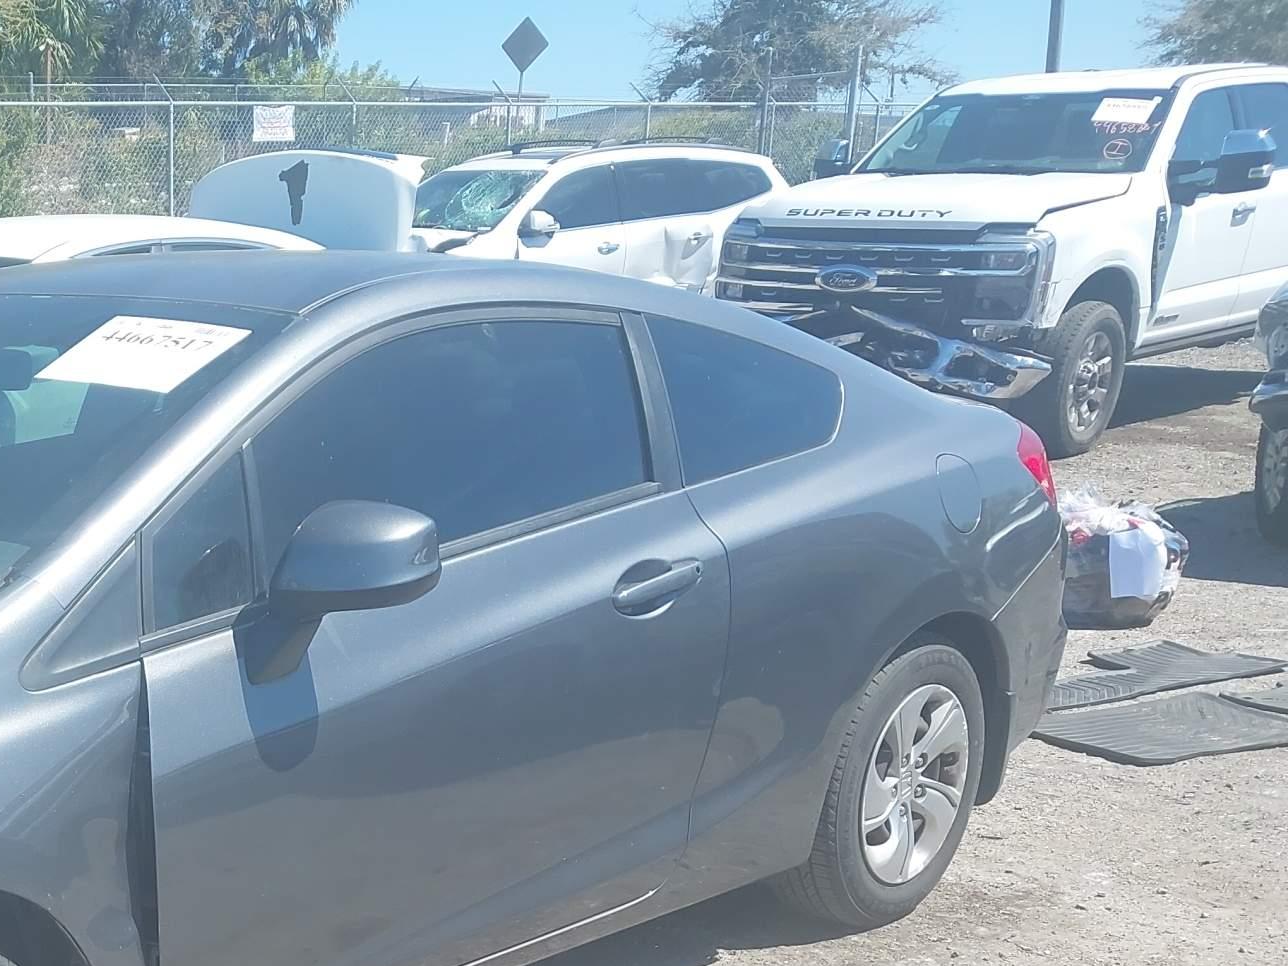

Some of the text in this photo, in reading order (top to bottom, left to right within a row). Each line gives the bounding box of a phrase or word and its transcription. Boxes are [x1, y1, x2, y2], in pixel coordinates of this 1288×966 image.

[786, 208, 953, 218] SUPER DUTY
[828, 272, 858, 287] Ford
